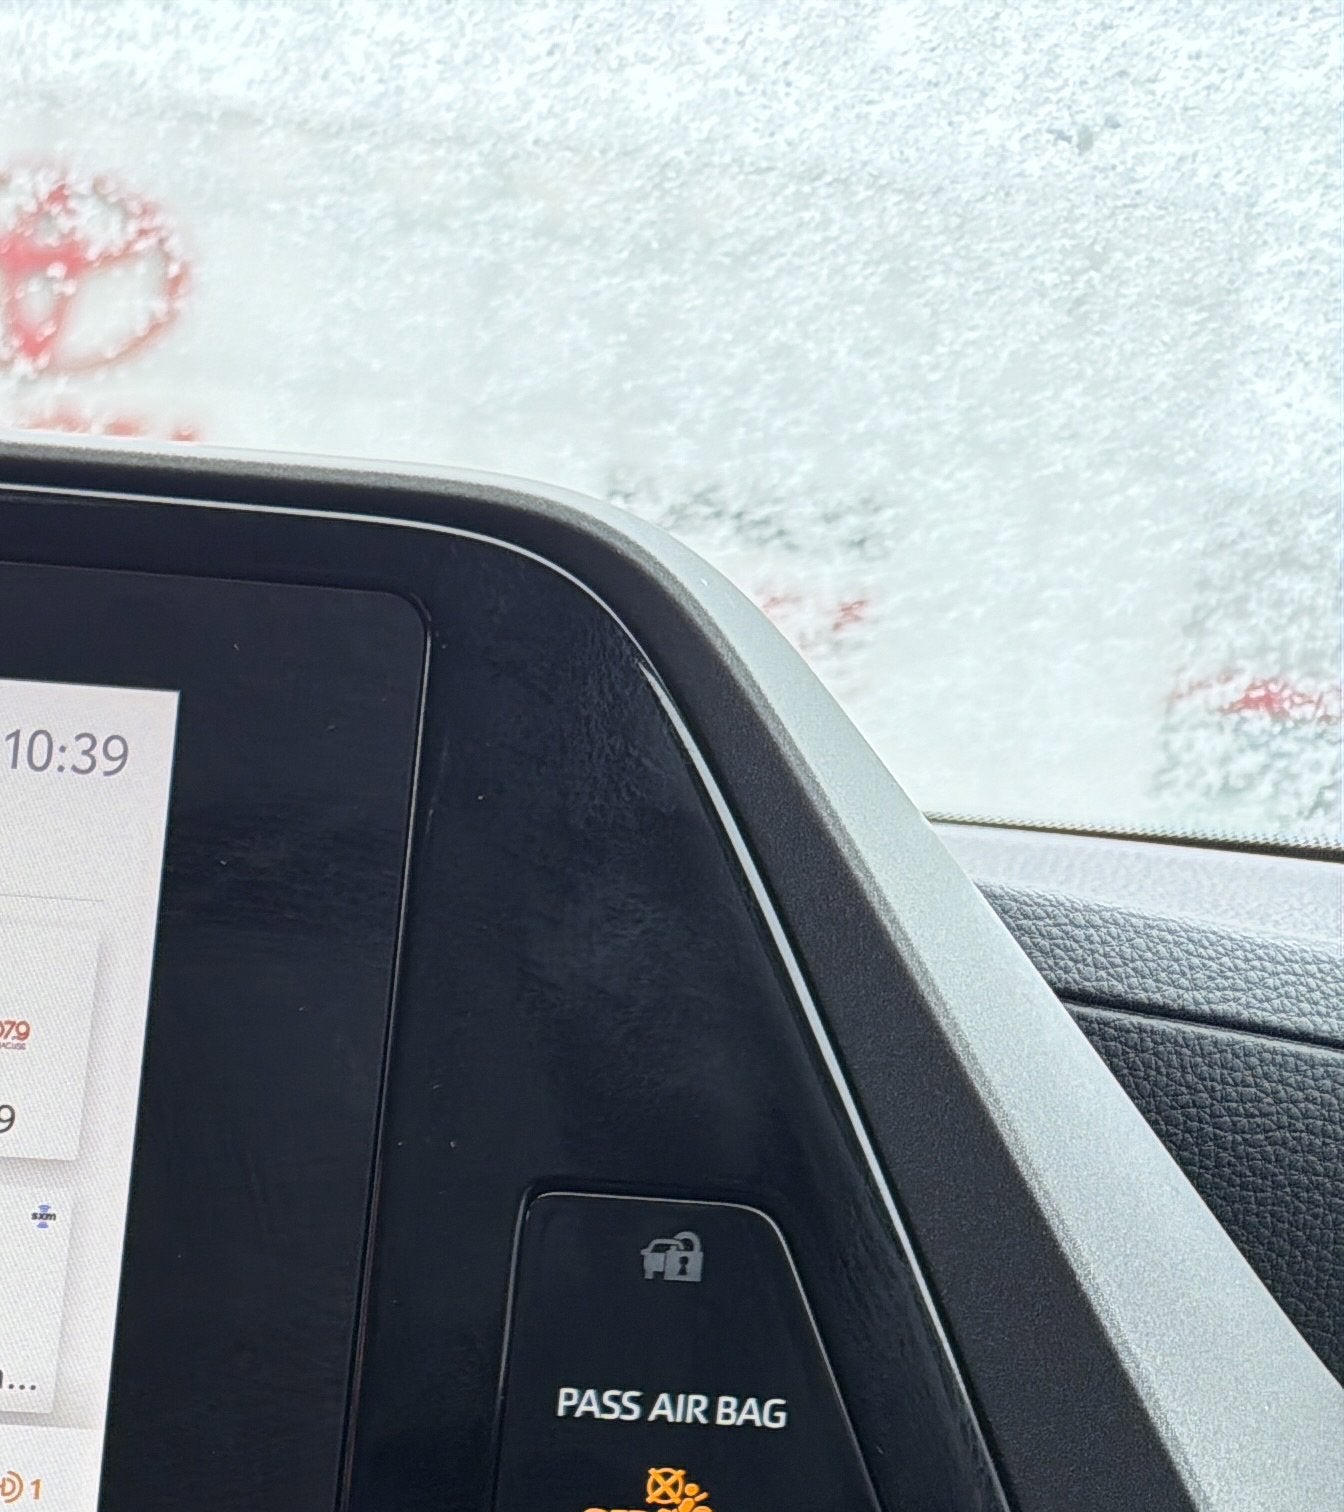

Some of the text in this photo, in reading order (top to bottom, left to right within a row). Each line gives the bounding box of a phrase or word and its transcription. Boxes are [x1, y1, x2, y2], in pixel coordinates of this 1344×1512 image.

[4, 727, 130, 778] 10:39
[556, 1386, 788, 1430] PASS AIR BAG
[30, 1478, 41, 1500] 1
